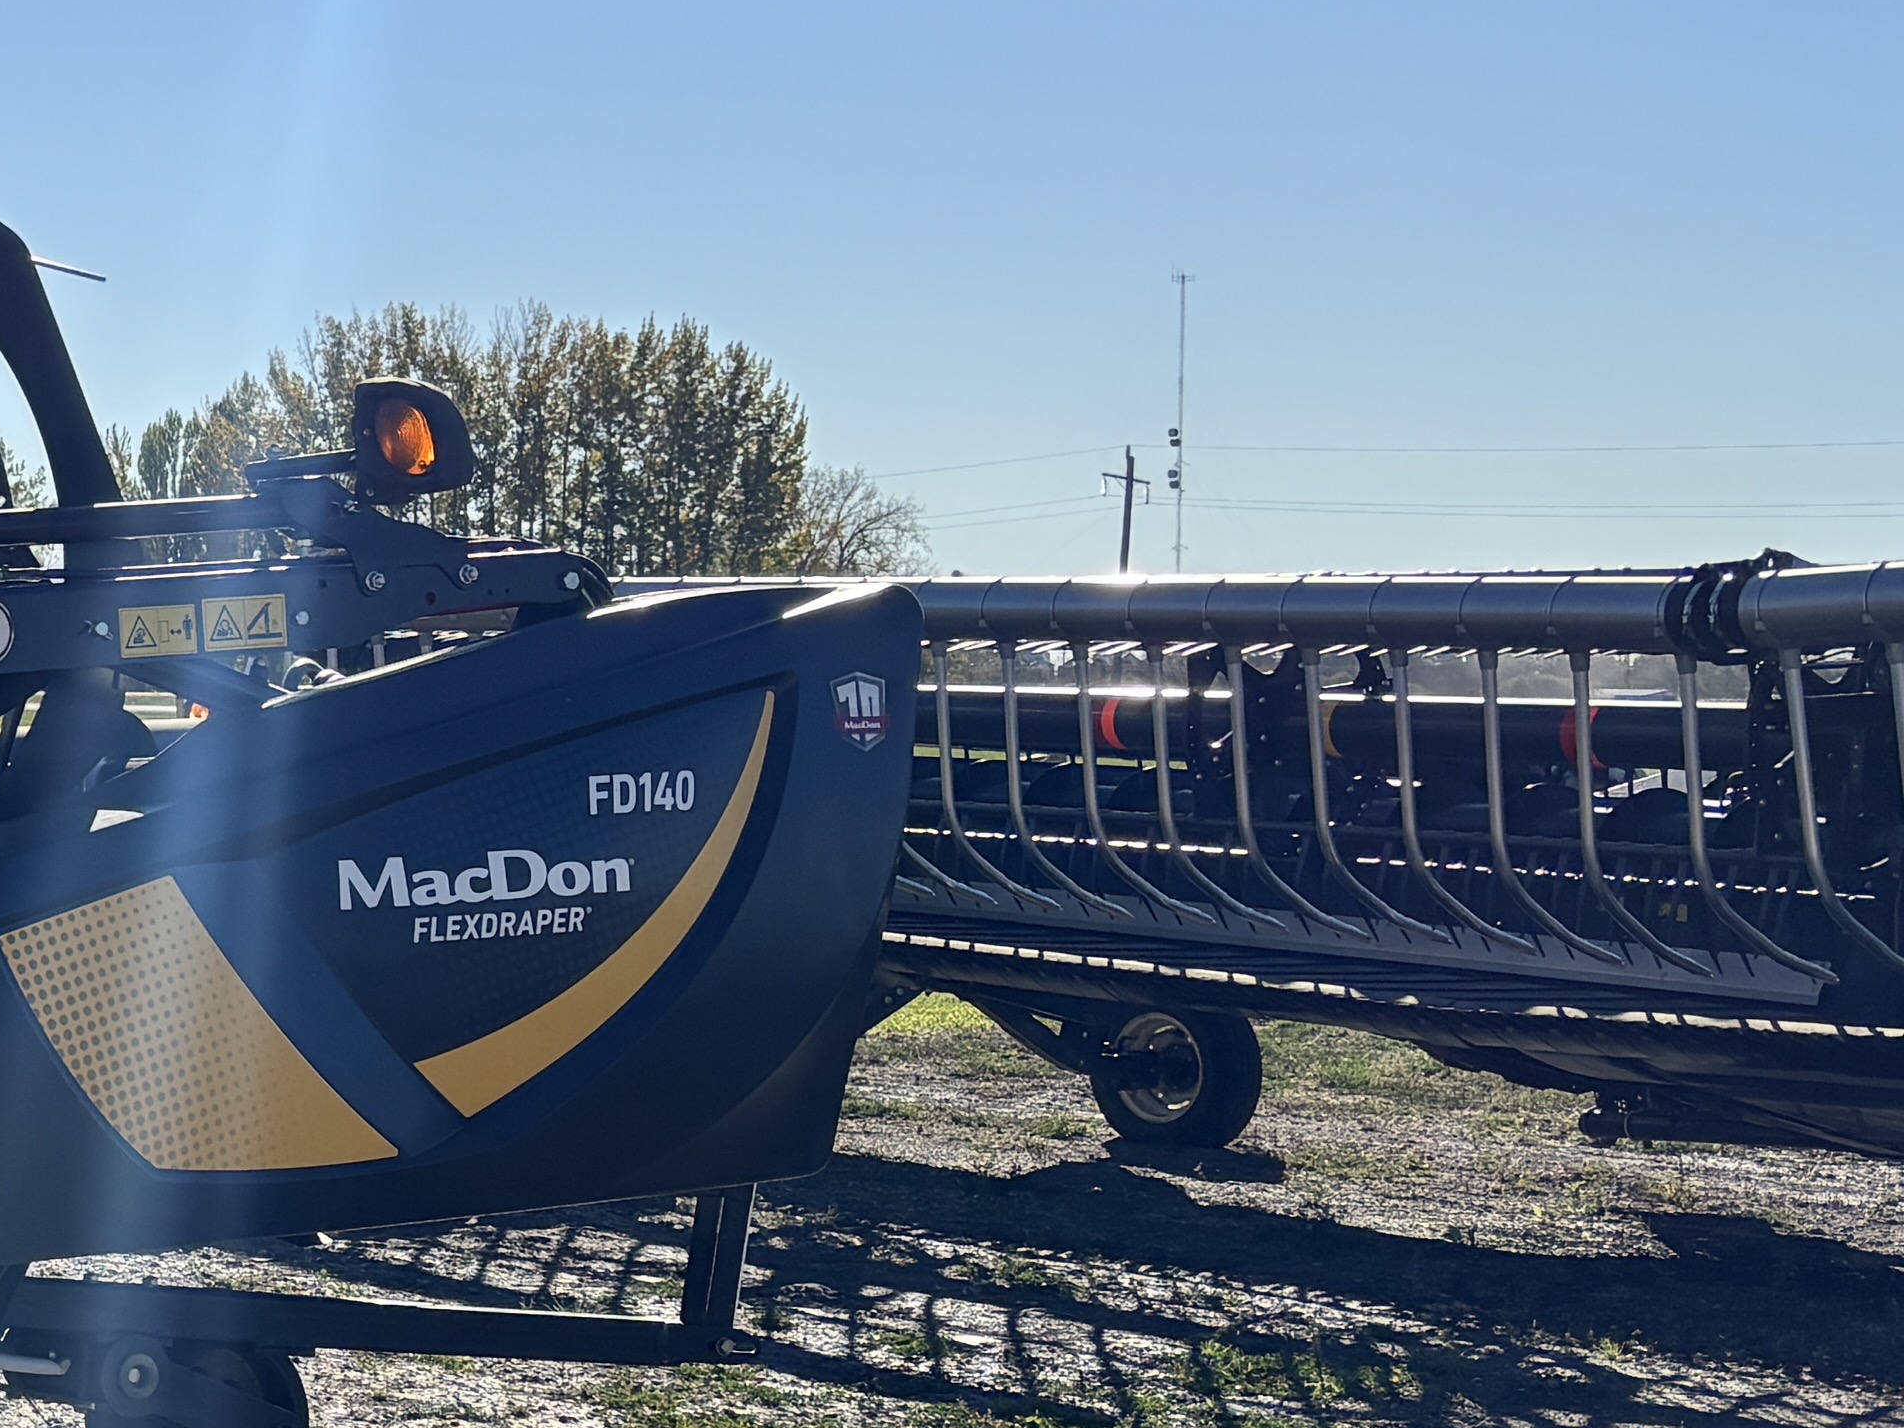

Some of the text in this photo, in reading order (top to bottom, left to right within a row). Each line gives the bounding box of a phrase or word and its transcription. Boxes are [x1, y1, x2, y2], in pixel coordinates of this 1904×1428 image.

[588, 770, 695, 815] FD140
[338, 849, 631, 910] MacDon
[413, 907, 587, 943] FLEXDRAPER
